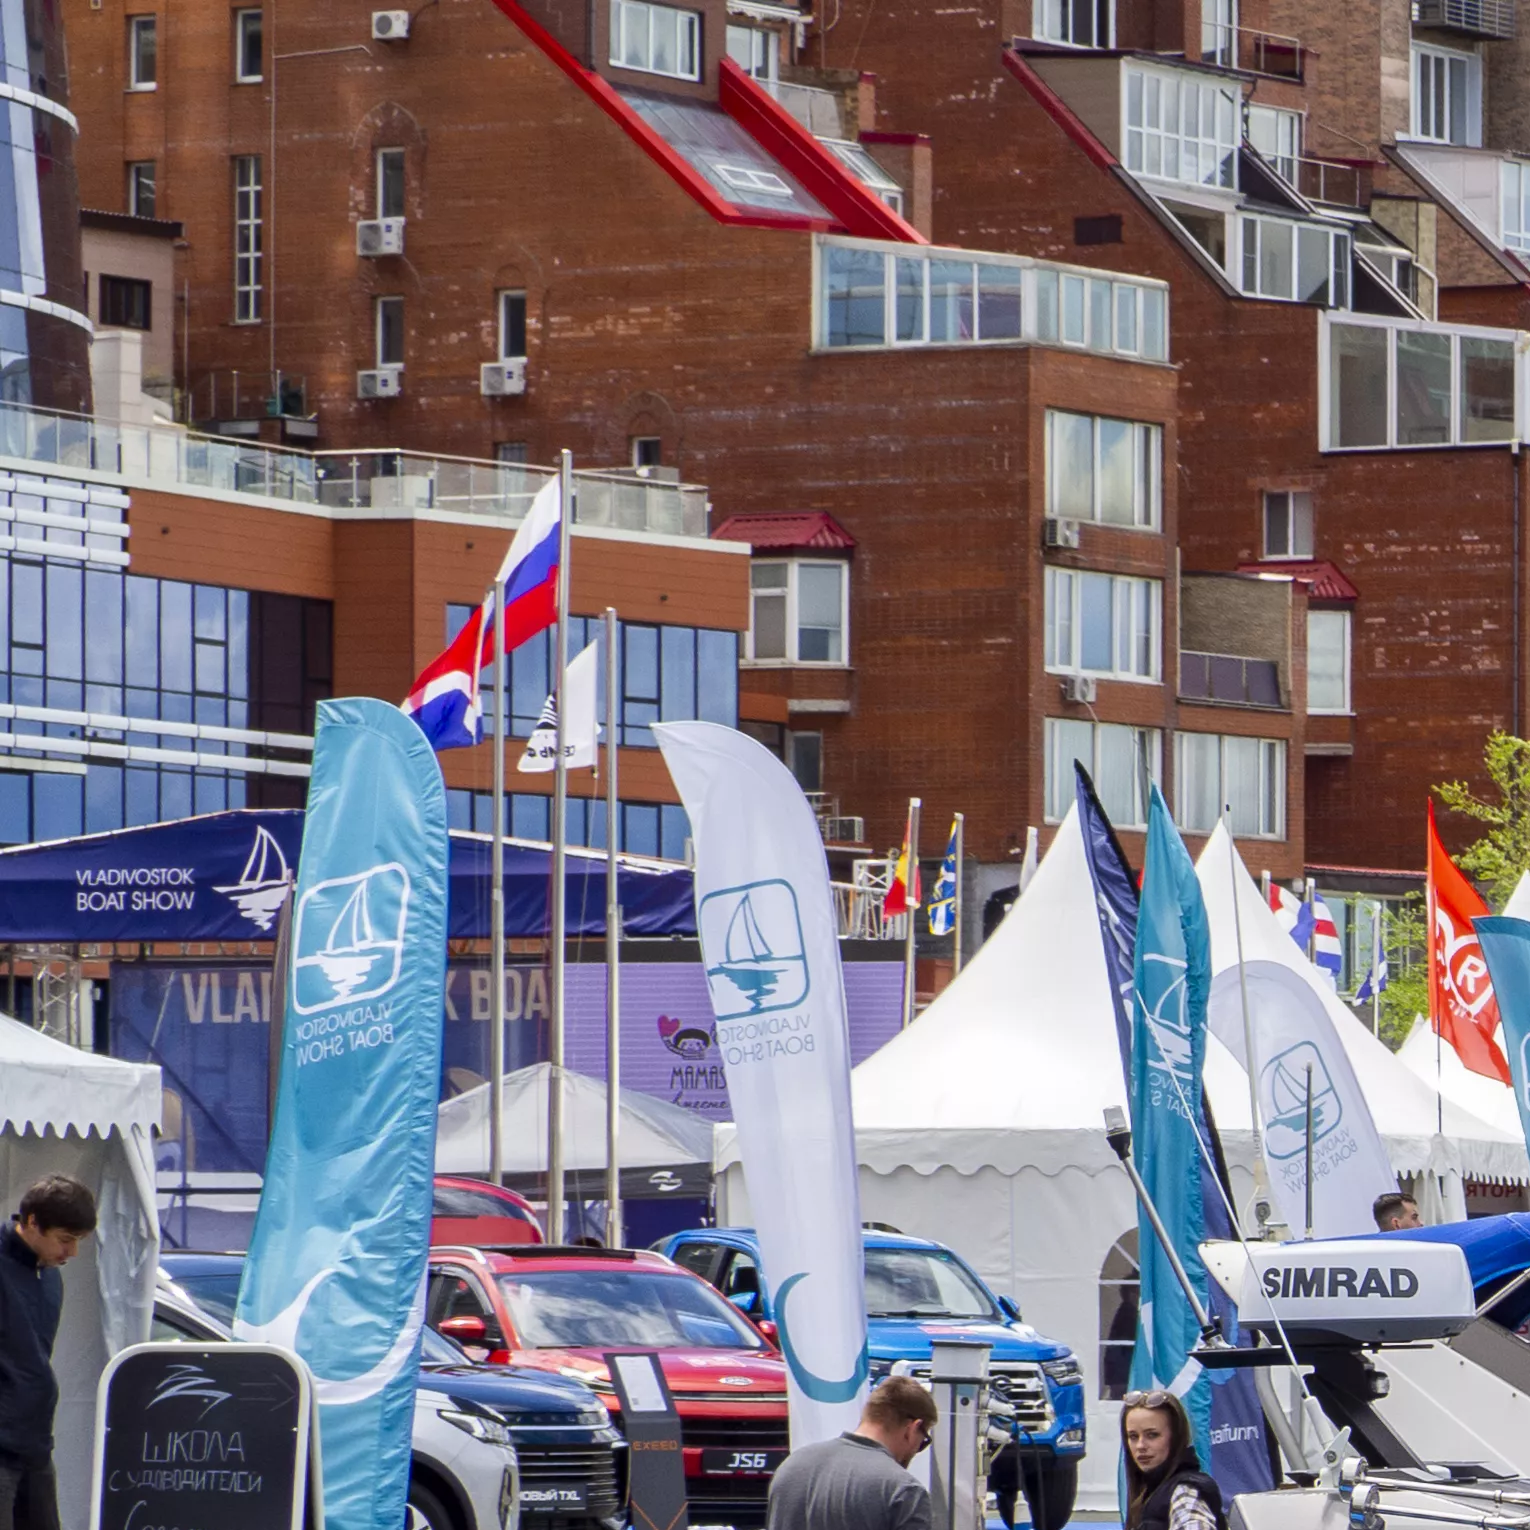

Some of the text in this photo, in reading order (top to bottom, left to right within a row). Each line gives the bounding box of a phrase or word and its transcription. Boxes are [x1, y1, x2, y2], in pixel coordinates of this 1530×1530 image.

[76, 867, 195, 886] VLADIVOSTOK
[77, 890, 195, 912] BOAT SHOW
[470, 969, 550, 1021] BOA
[1261, 1267, 1419, 1299] SIMRAD
[142, 1430, 246, 1463] ШКОЛА
[632, 1440, 678, 1450] EXEED
[727, 1452, 767, 1468] JS6
